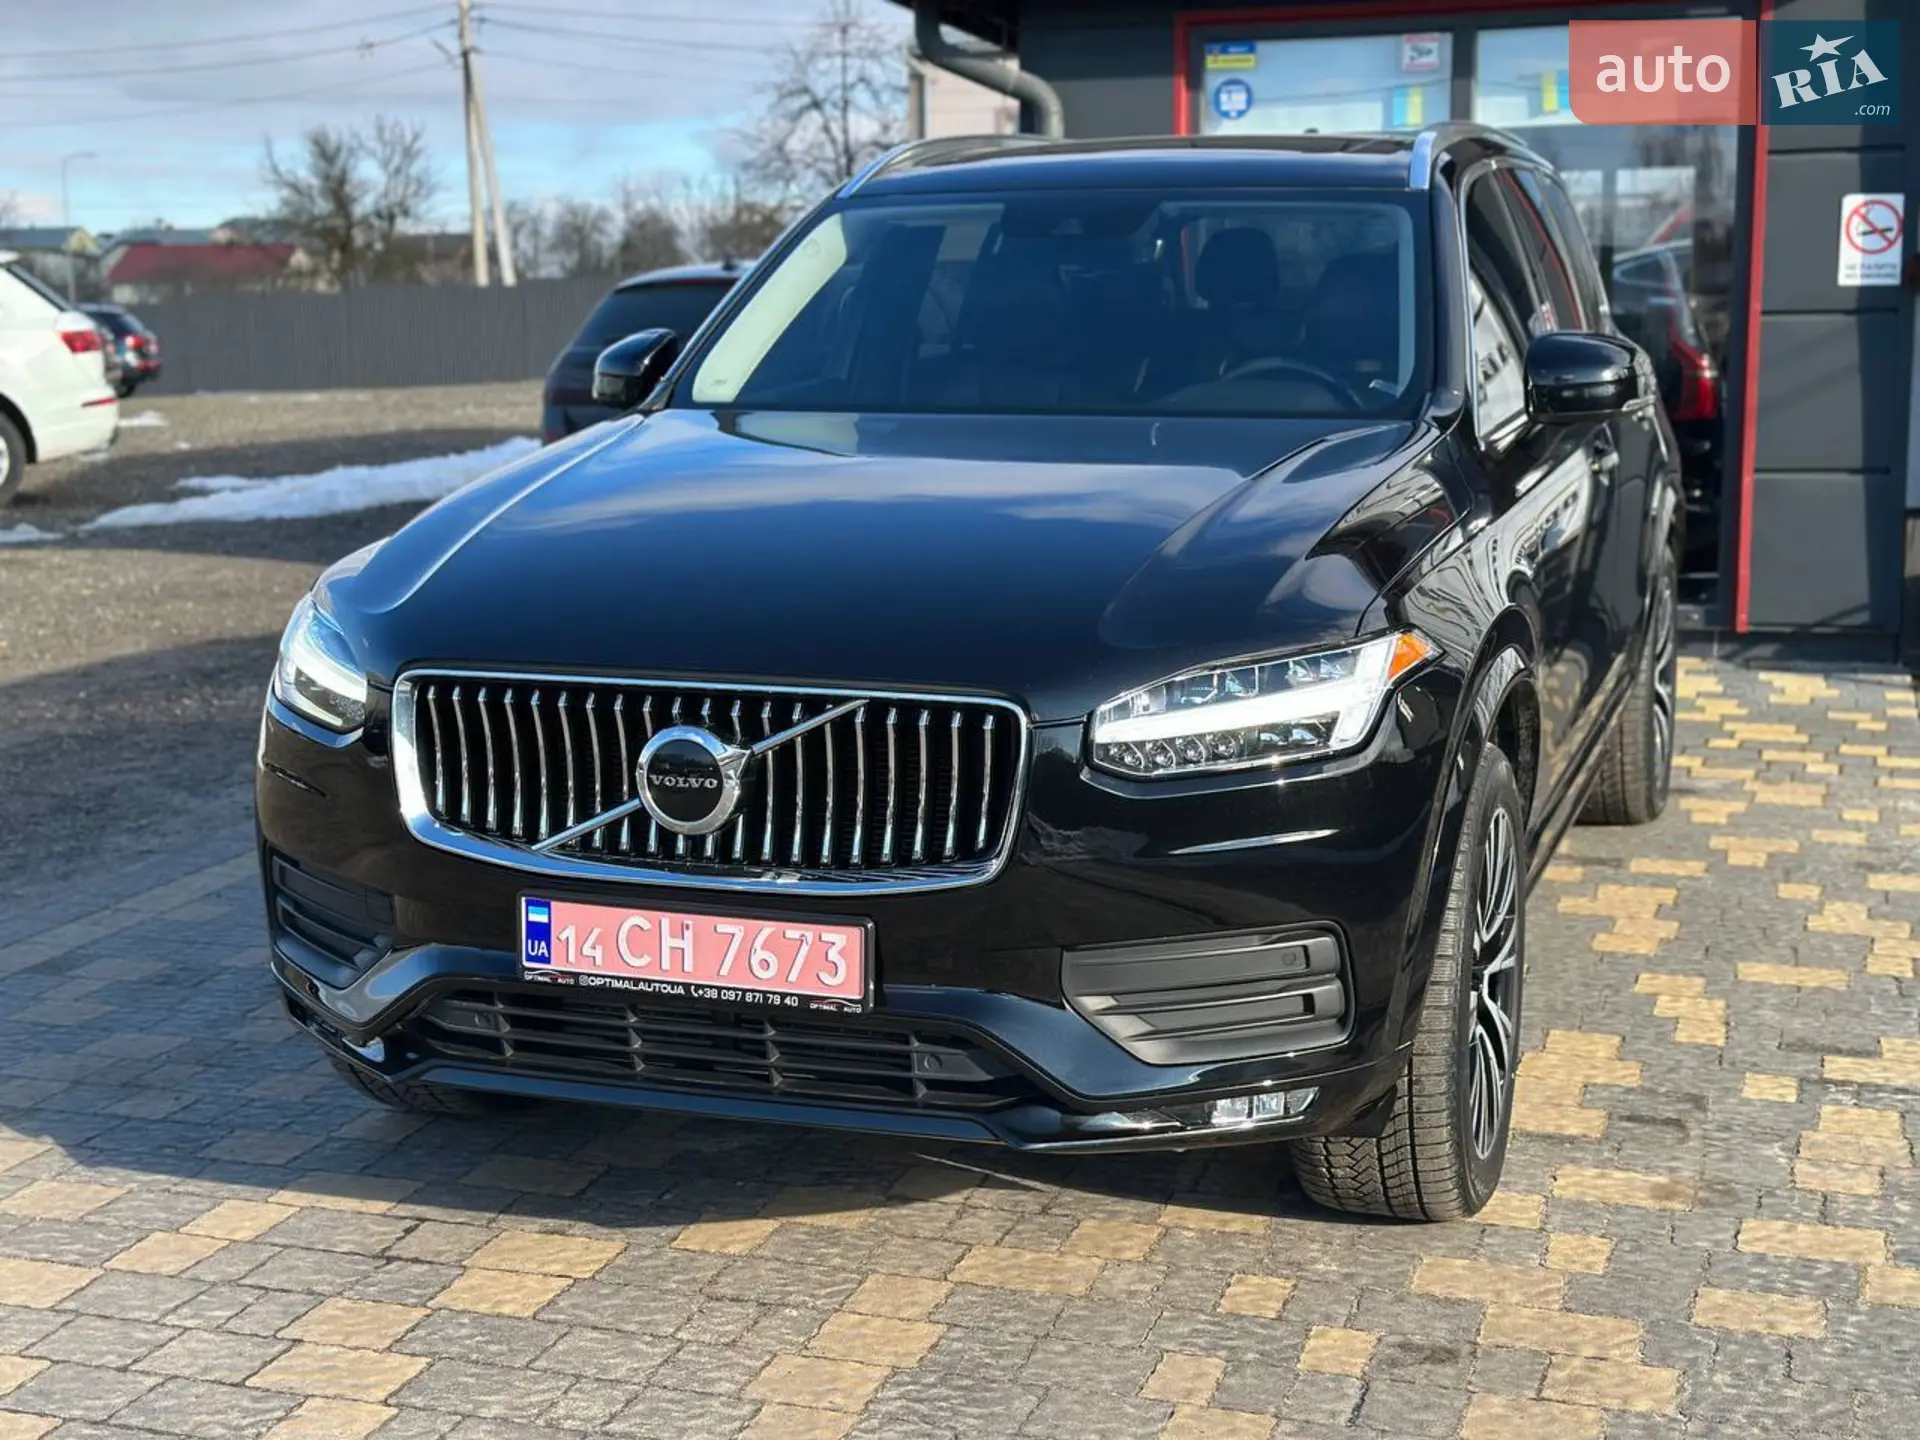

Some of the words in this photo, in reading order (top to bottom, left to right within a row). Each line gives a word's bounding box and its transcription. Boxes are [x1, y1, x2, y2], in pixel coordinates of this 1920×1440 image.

[648, 774, 719, 789] VOLVO
[528, 941, 550, 958] UA
[556, 925, 603, 966] 14
[616, 916, 694, 973] CH
[713, 925, 848, 987] 7673
[524, 973, 552, 982] OPTIMAL
[557, 977, 575, 985] AUTO
[721, 990, 742, 1001] 097
[745, 993, 763, 1004] 871
[784, 996, 799, 1007] 40
[843, 1004, 862, 1014] AUTO
